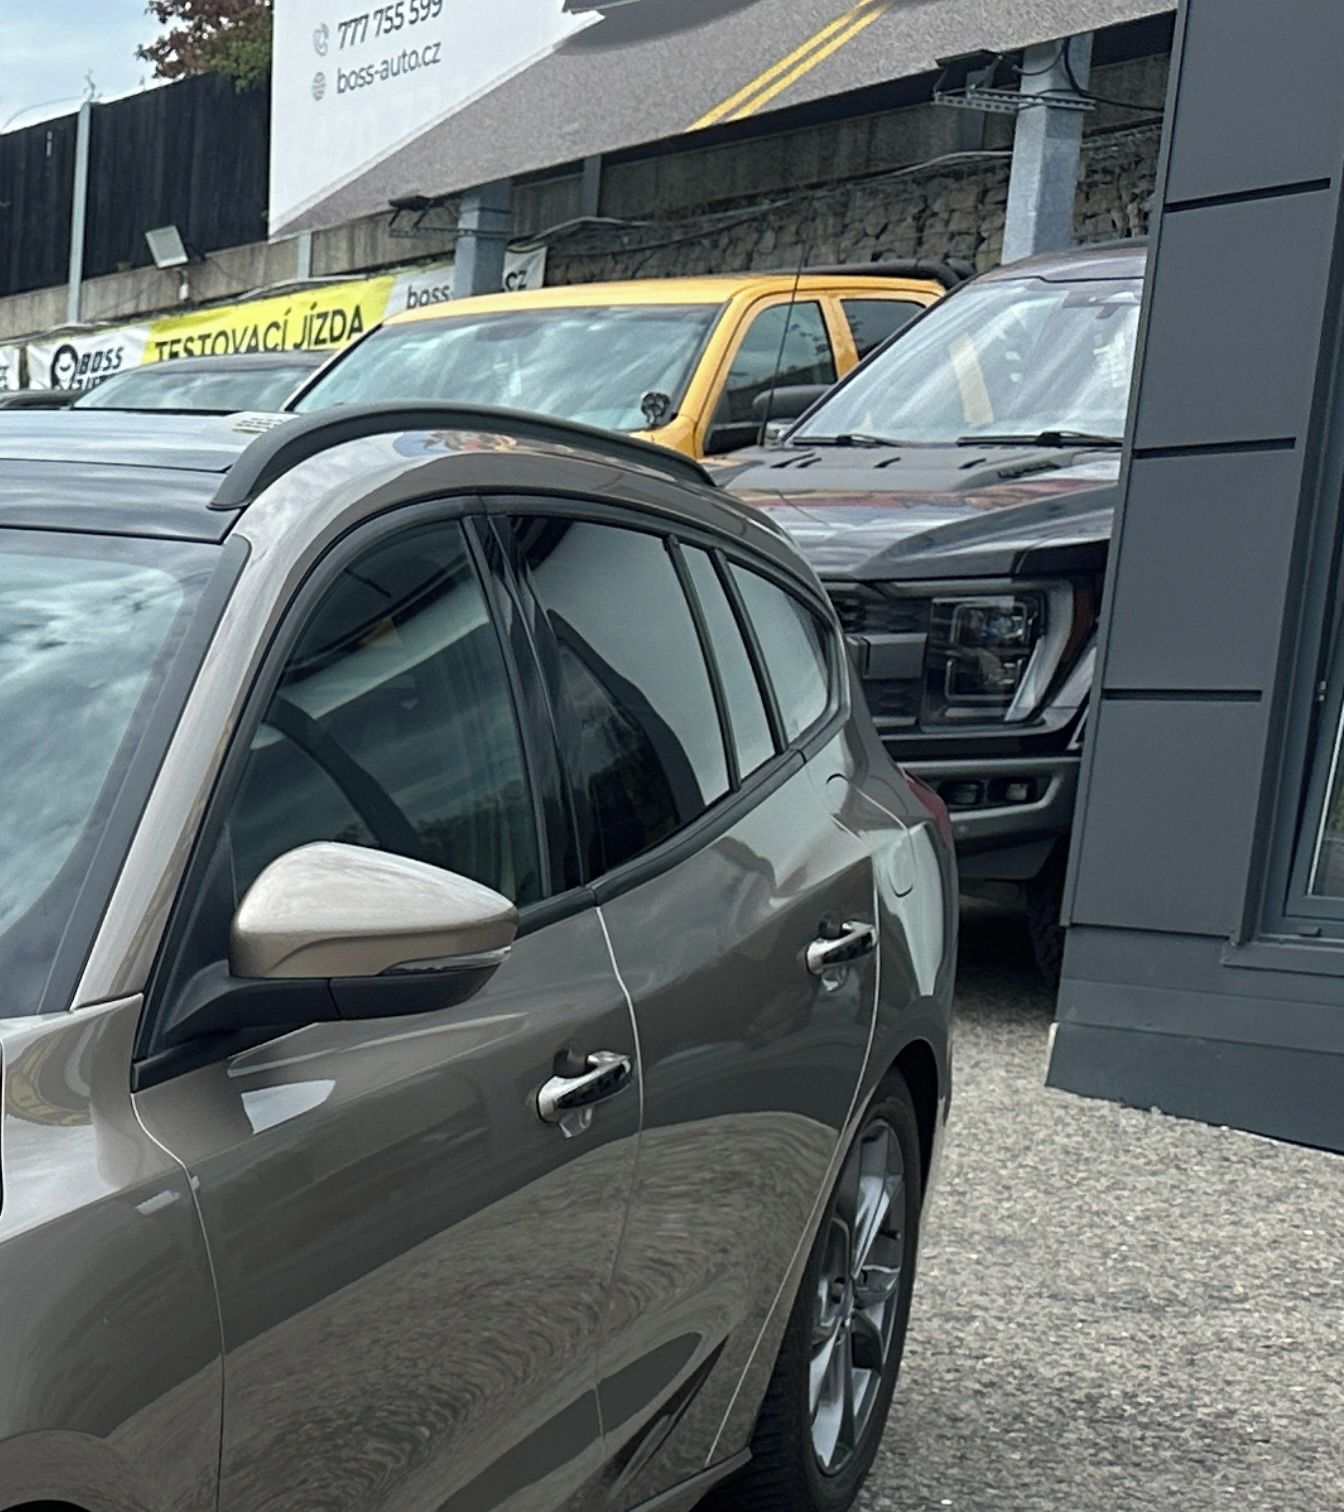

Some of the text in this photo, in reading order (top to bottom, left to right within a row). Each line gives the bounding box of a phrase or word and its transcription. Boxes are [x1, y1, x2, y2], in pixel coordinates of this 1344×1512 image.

[337, 0, 443, 50] 777 755 599
[337, 42, 442, 94] boss-auto.cz
[293, 302, 364, 351] JÍZDA
